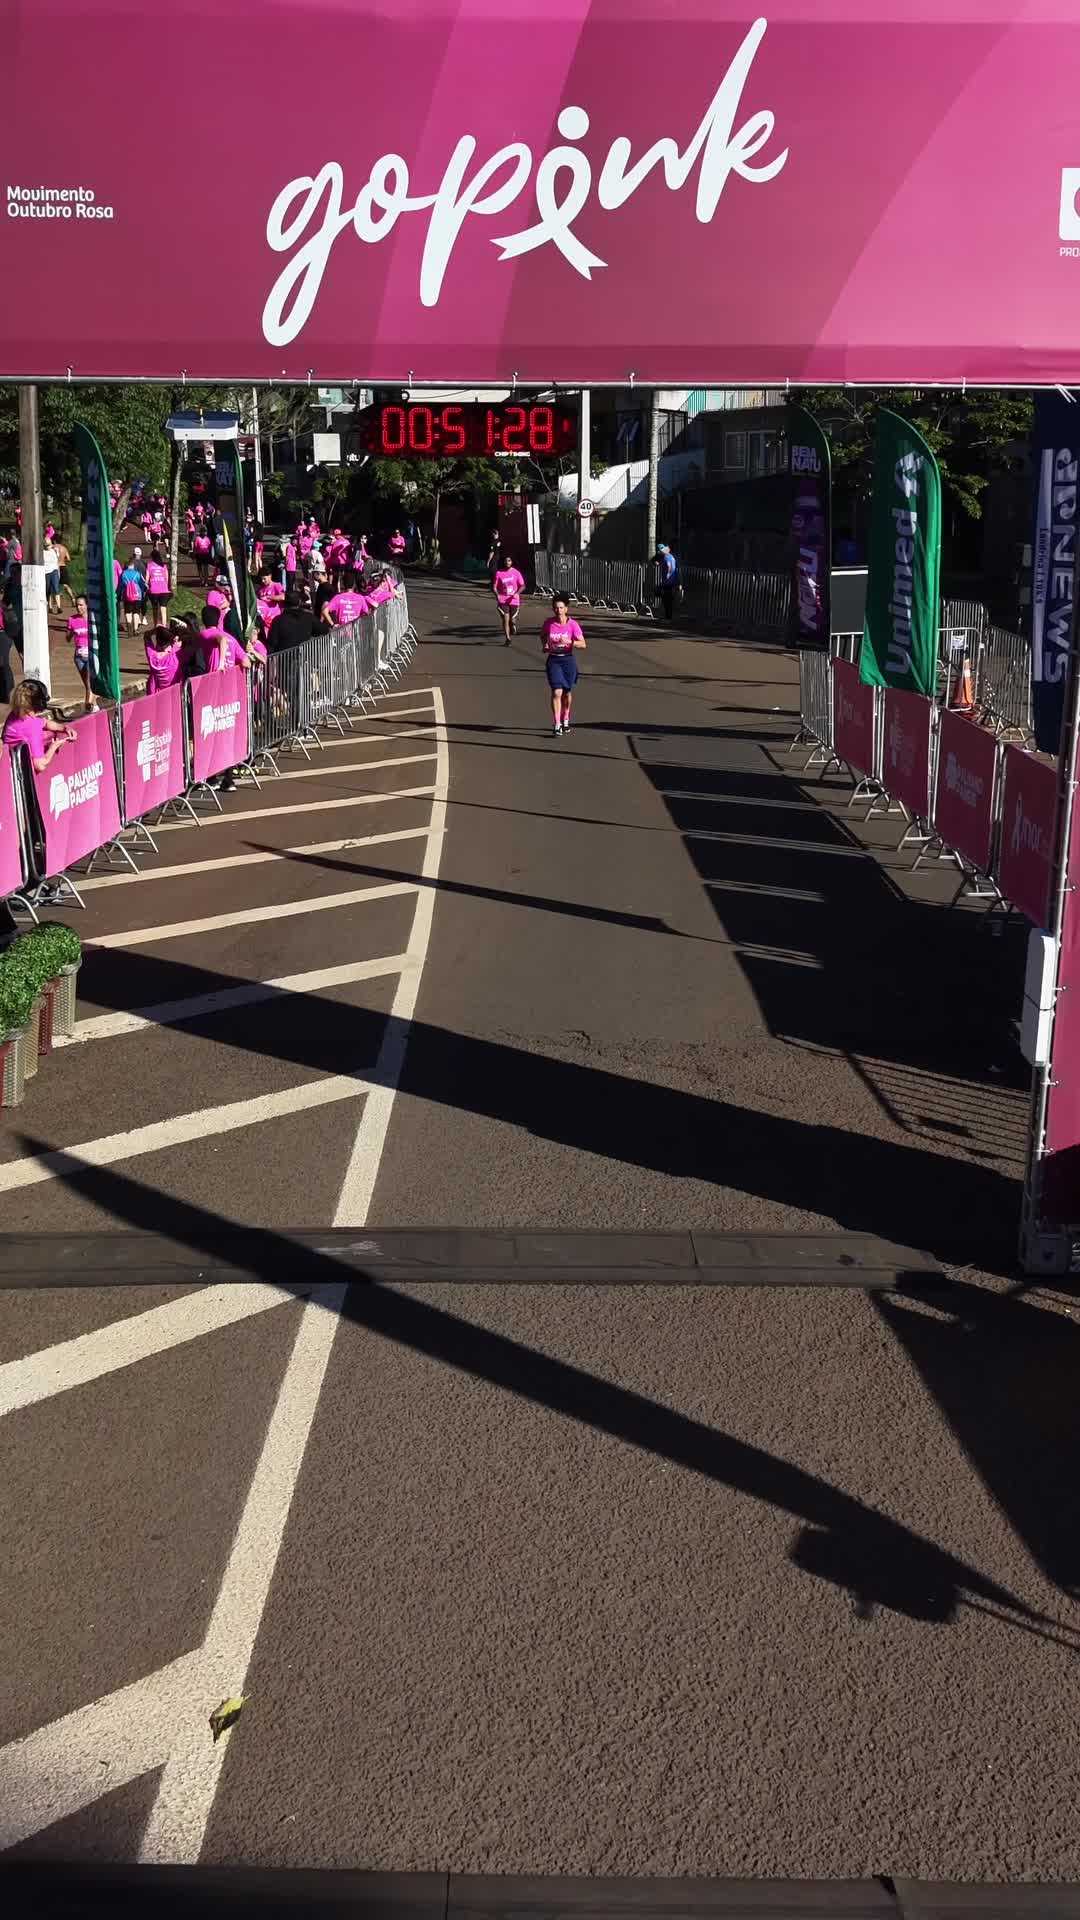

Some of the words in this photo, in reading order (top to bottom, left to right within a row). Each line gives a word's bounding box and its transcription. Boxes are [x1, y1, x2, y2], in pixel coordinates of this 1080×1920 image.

[7, 186, 95, 201] Movimento
[7, 202, 72, 218] Outubro
[76, 203, 114, 218] Rosa
[1060, 247, 1080, 257] PRO
[580, 502, 592, 510] 40
[883, 507, 917, 674] Unimed
[68, 760, 104, 793] PALHANO
